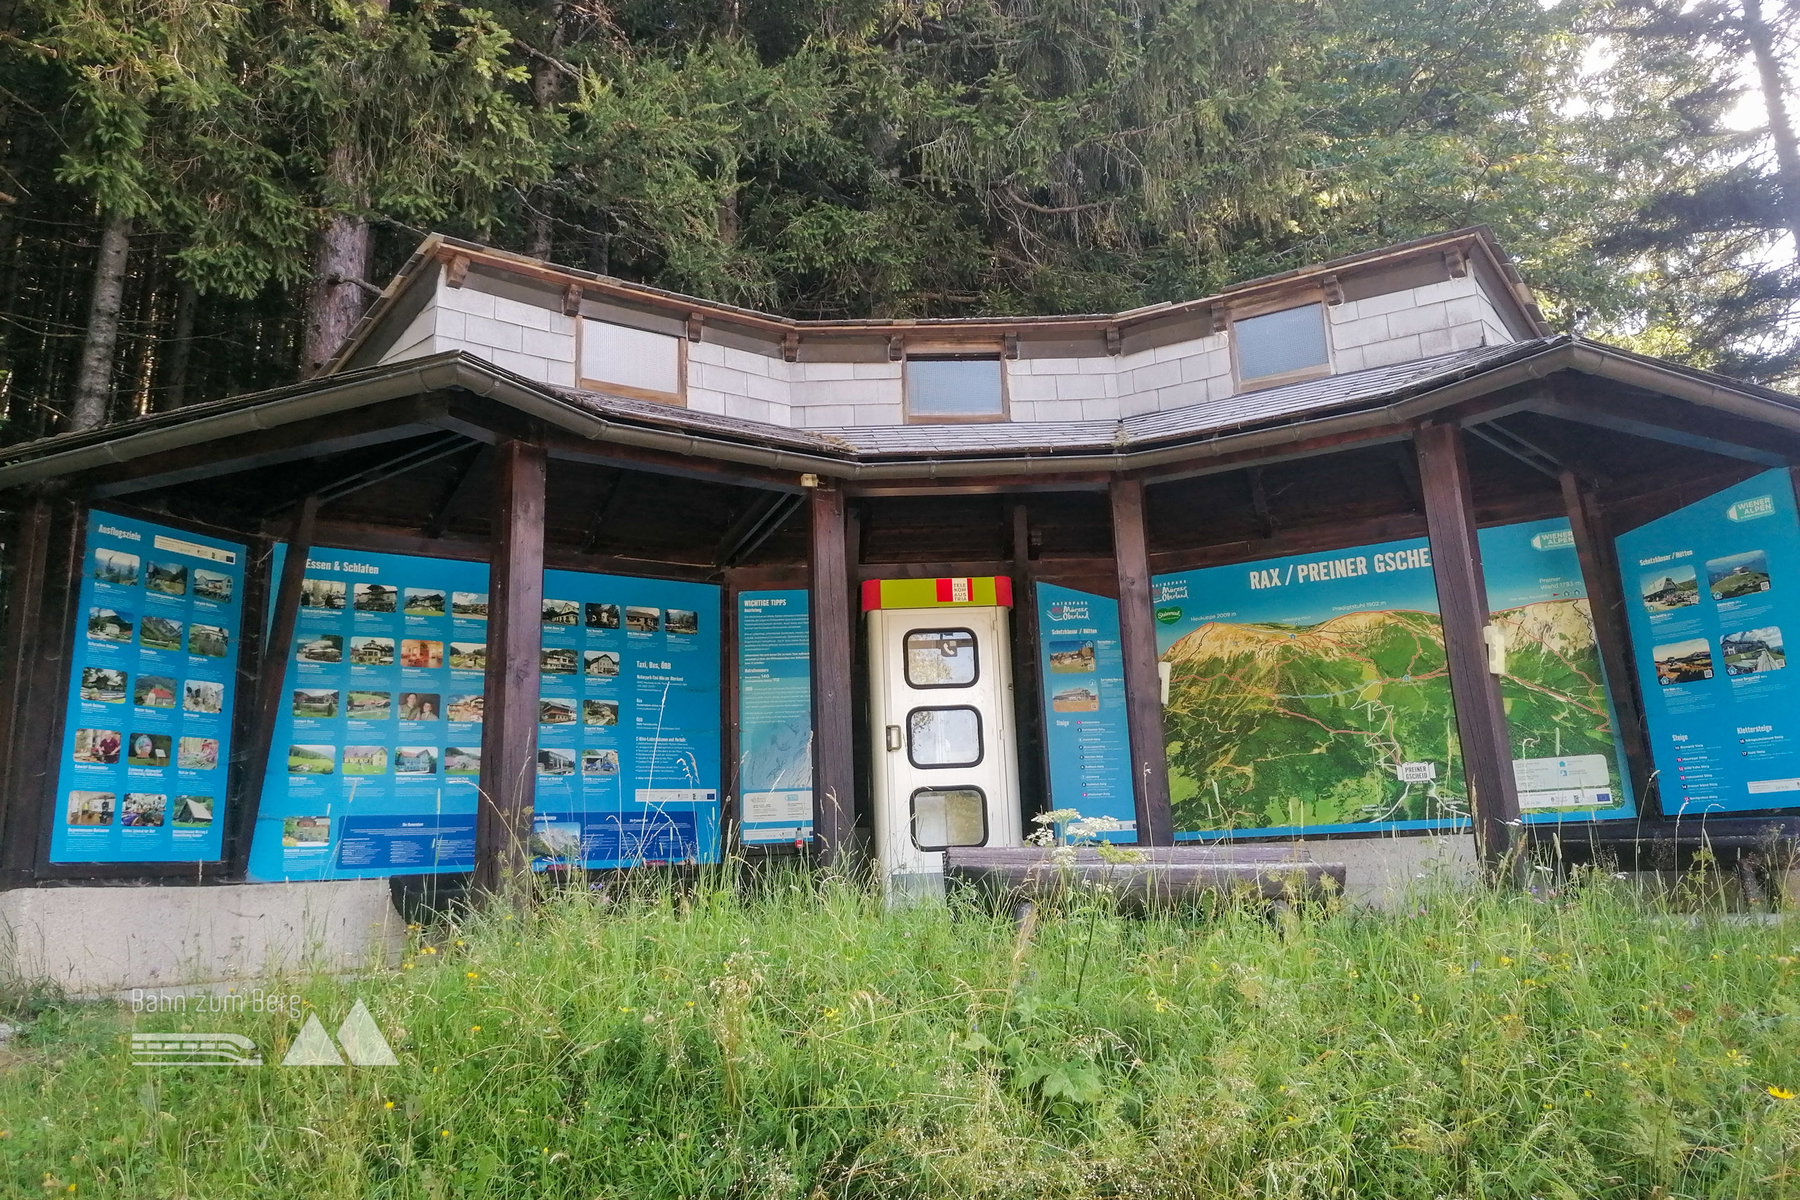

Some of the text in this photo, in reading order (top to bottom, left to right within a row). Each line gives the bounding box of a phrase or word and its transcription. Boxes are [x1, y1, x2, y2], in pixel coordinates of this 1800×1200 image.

[1738, 498, 1770, 510] WIENER
[1744, 504, 1772, 514] ALPEN
[98, 523, 142, 542] Ausflugsziele
[306, 559, 379, 575] Essen & Schlafen
[1250, 567, 1281, 590] RAX
[1297, 556, 1368, 583] PREINER
[1374, 547, 1432, 573] GSCHE
[744, 598, 787, 607] WICHTIGE TIPPS
[1405, 765, 1427, 773] PREINER
[1405, 772, 1428, 780] GSCHEID
